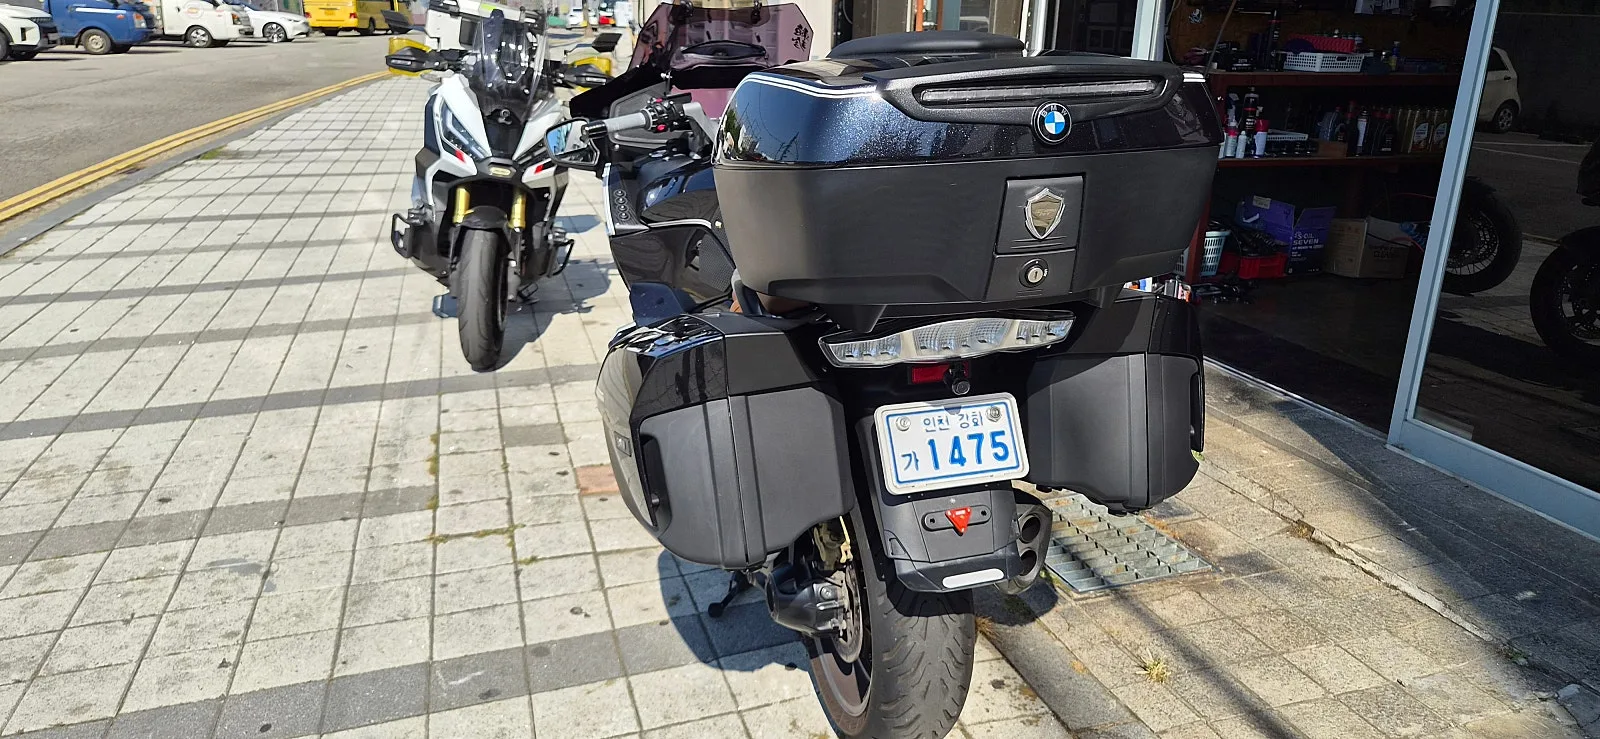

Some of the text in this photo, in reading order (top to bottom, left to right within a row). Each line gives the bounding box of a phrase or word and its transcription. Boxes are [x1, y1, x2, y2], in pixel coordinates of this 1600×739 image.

[1041, 104, 1069, 118] BMW
[1293, 238, 1319, 246] SEVEN
[923, 415, 950, 432] 인천
[901, 430, 1010, 471] 가 1475
